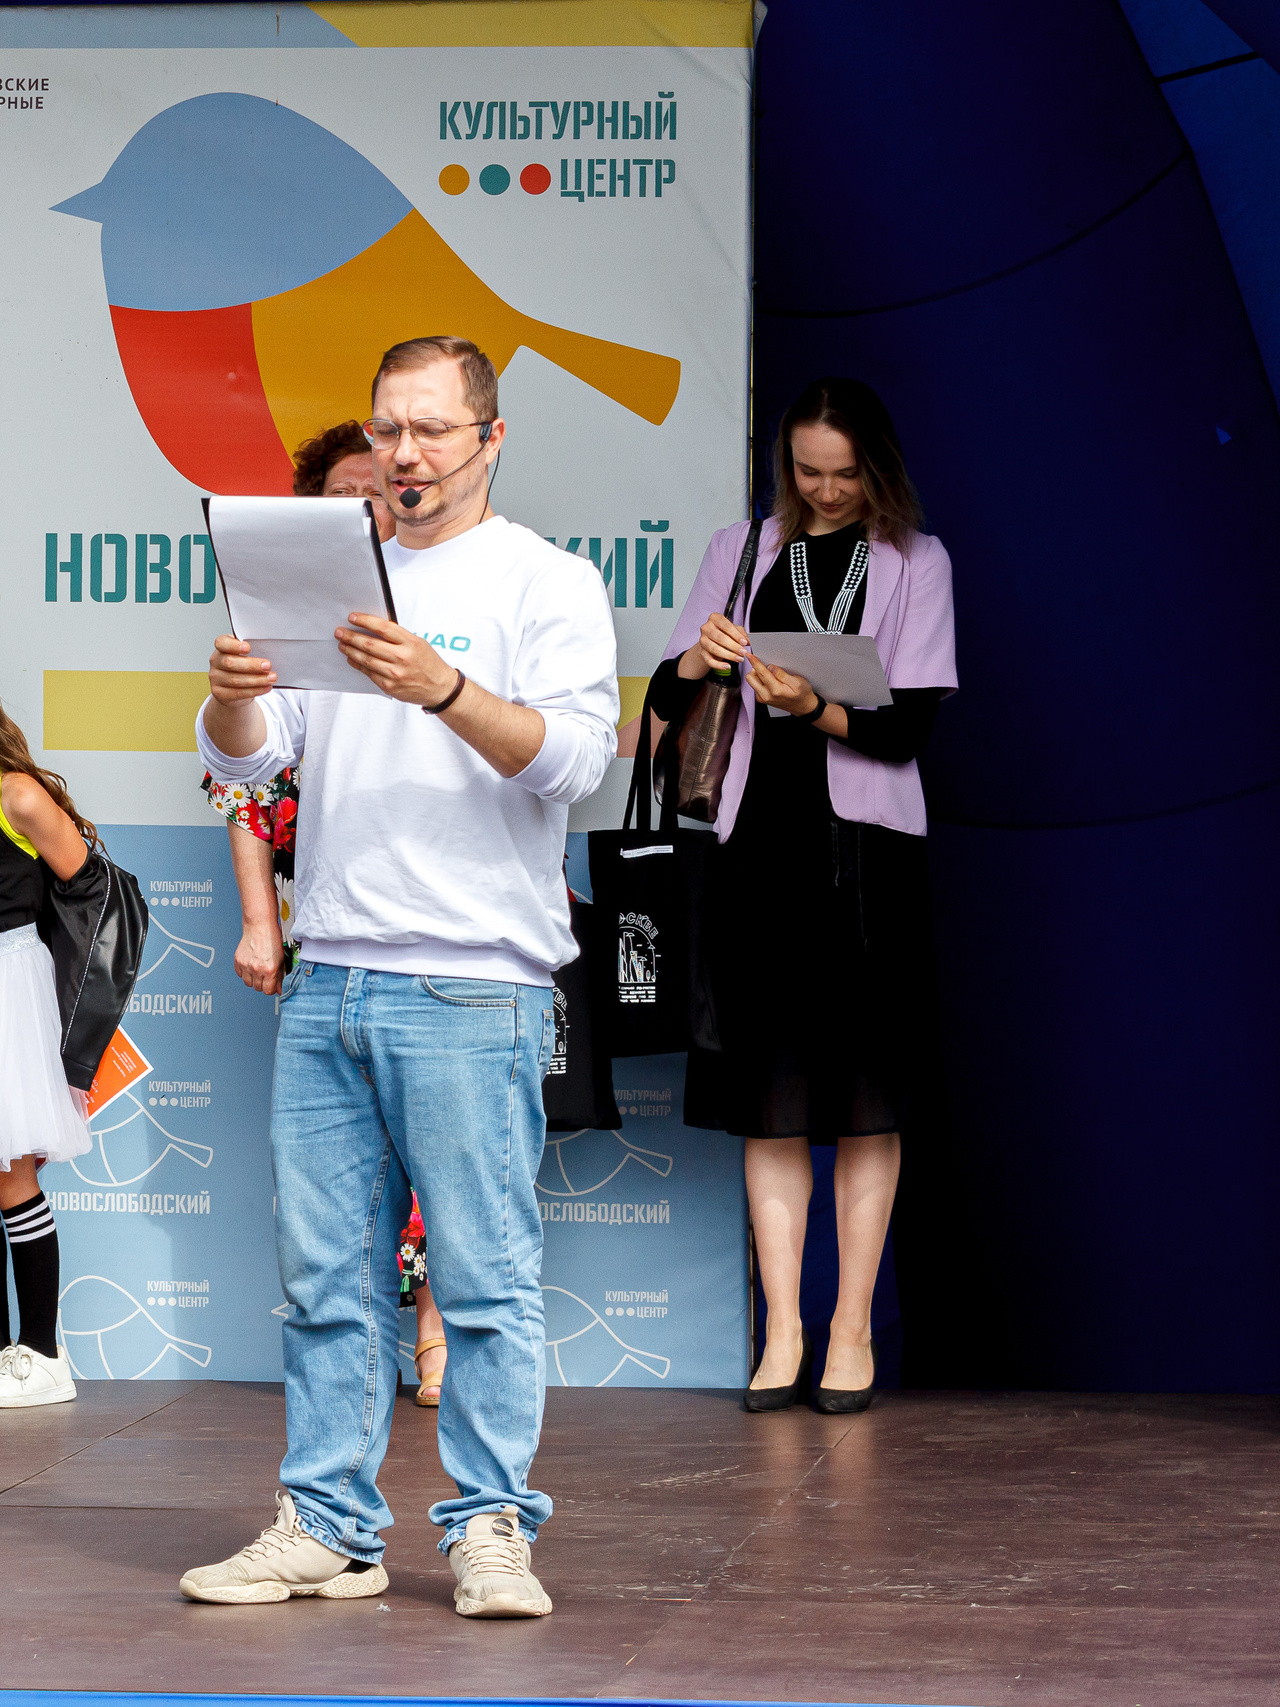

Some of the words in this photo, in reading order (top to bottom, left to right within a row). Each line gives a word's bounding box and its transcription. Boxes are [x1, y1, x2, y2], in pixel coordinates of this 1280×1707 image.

[438, 91, 678, 141] КУЛЬТУРНЫЙ
[559, 158, 676, 203] ЦЕНТР
[149, 878, 213, 894] КУЛЬТУРНЫЙ
[181, 896, 213, 910] ЦЕНТР
[124, 990, 212, 1016] БОДСКИЙ
[148, 1080, 212, 1095] КУЛЬТУРНЫЙ
[613, 1087, 672, 1102] УЛЬТУРНЫЙ
[179, 1096, 212, 1110] ЦЕНТР
[639, 1104, 672, 1118] ЦЕНТР
[46, 1190, 211, 1216] НОВОСЛОБОДСКИЙ
[538, 1199, 670, 1225] ОСЛОБОДСКИЙ
[147, 1280, 210, 1294] КУЛЬТУРНЫЙ
[178, 1295, 210, 1309] ЦЕНТР
[605, 1289, 669, 1304] КУЛЬТУРНЫЙ
[637, 1306, 669, 1319] ЦЕНТР
